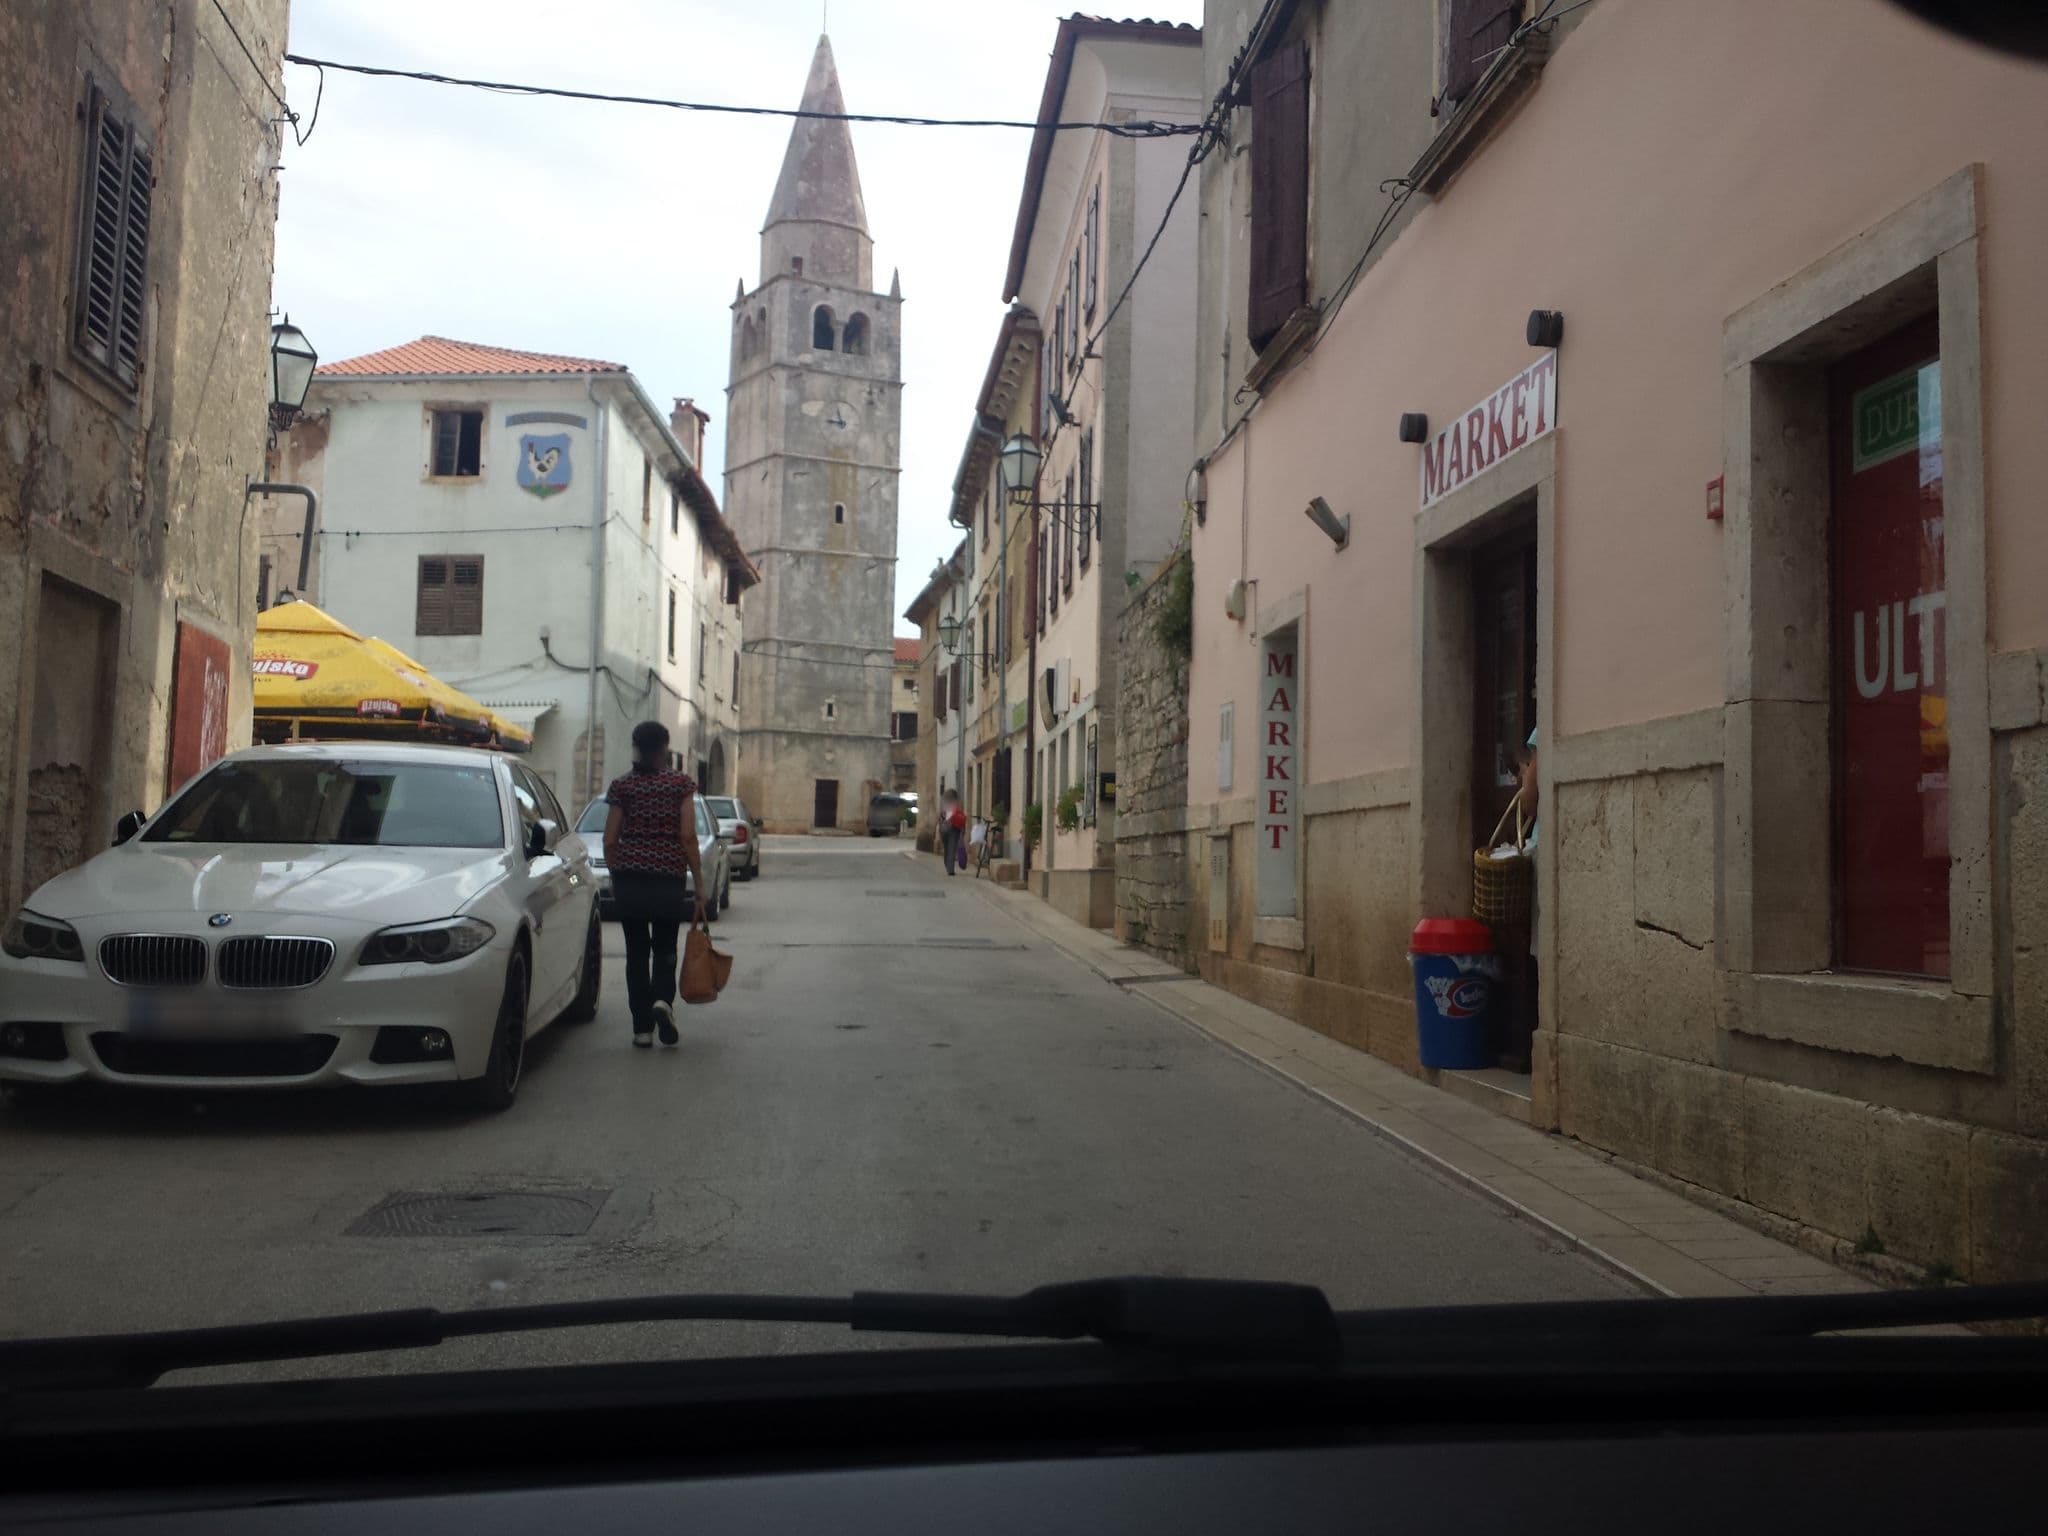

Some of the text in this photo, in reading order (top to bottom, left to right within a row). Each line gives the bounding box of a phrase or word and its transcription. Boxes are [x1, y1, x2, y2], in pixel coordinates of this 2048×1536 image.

[1423, 354, 1555, 505] MARKET
[1854, 590, 1947, 698] ULT
[1265, 653, 1294, 849] MARKET
